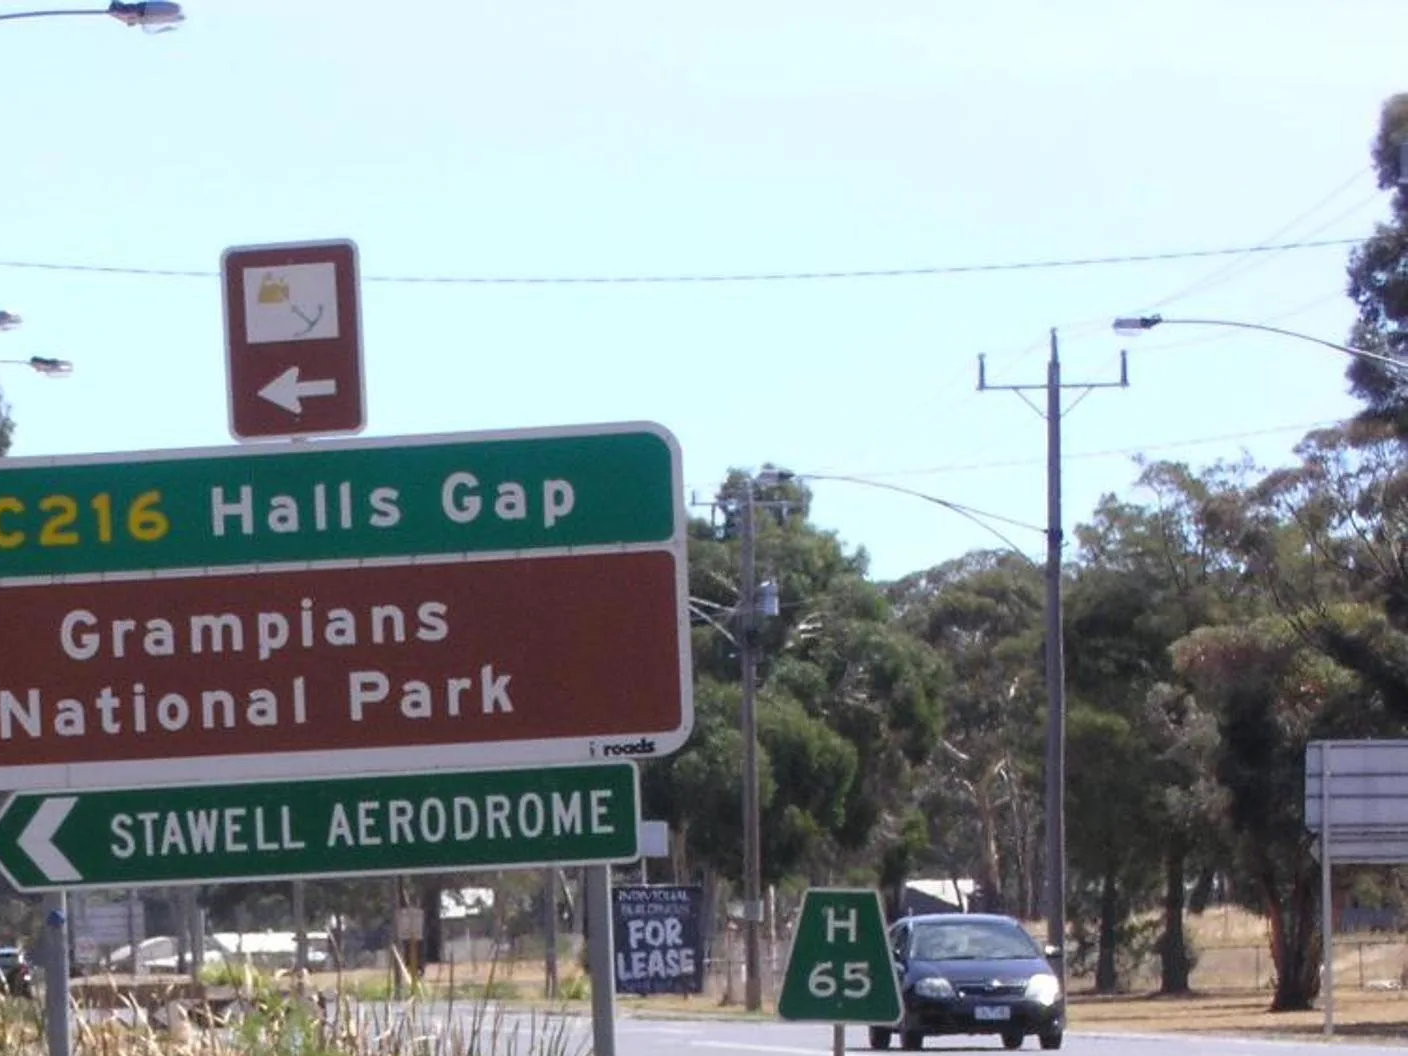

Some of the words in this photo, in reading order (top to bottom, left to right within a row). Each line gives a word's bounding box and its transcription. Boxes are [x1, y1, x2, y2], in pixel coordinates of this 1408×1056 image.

[211, 481, 401, 536] Halls
[441, 471, 576, 528] Gap
[59, 598, 450, 662] Grampians
[348, 665, 515, 722] Park
[110, 805, 306, 858] STAWELL
[327, 789, 616, 847] AERODROME
[628, 918, 683, 949] FOR
[826, 907, 857, 943] H
[617, 948, 695, 981] LEASE
[807, 960, 872, 999] 65
